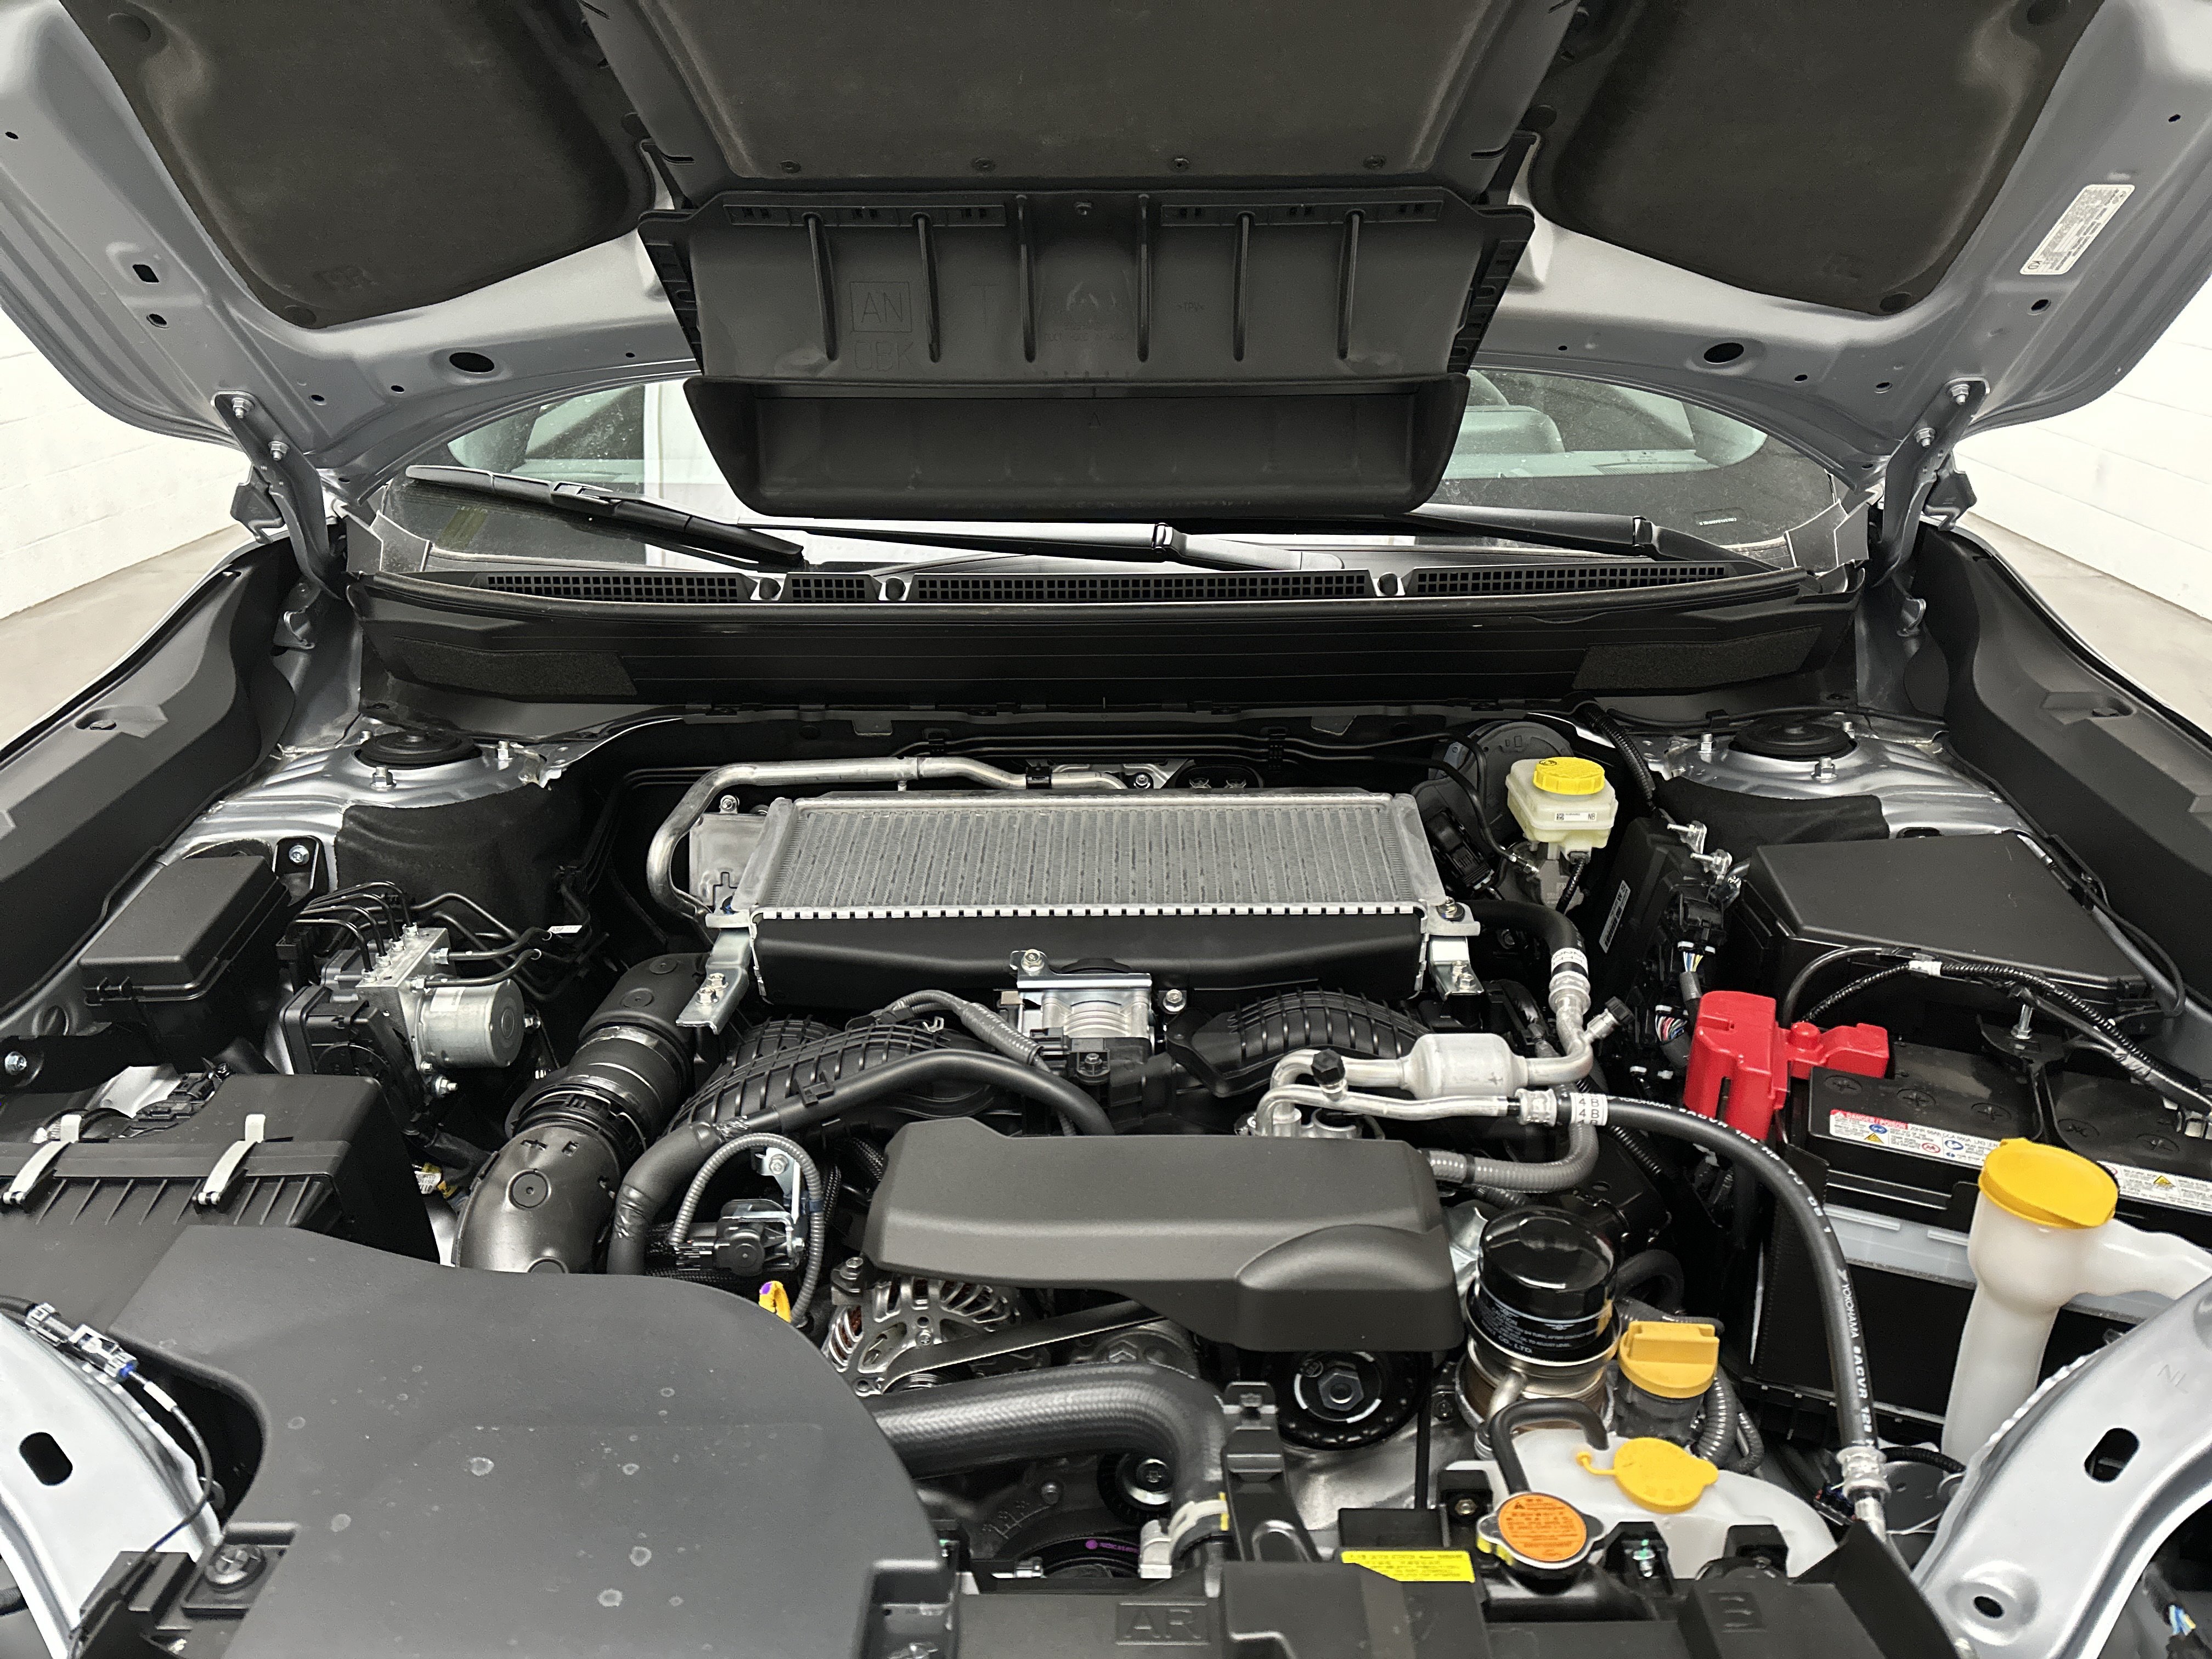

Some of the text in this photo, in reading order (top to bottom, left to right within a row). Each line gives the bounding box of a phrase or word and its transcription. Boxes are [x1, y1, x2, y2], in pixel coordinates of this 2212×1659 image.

[861, 291, 904, 323] AN
[1846, 1113, 1875, 1124] DANGER
[1842, 1284, 1859, 1338] YOKOHAMA
[1122, 1608, 1201, 1639] AR
